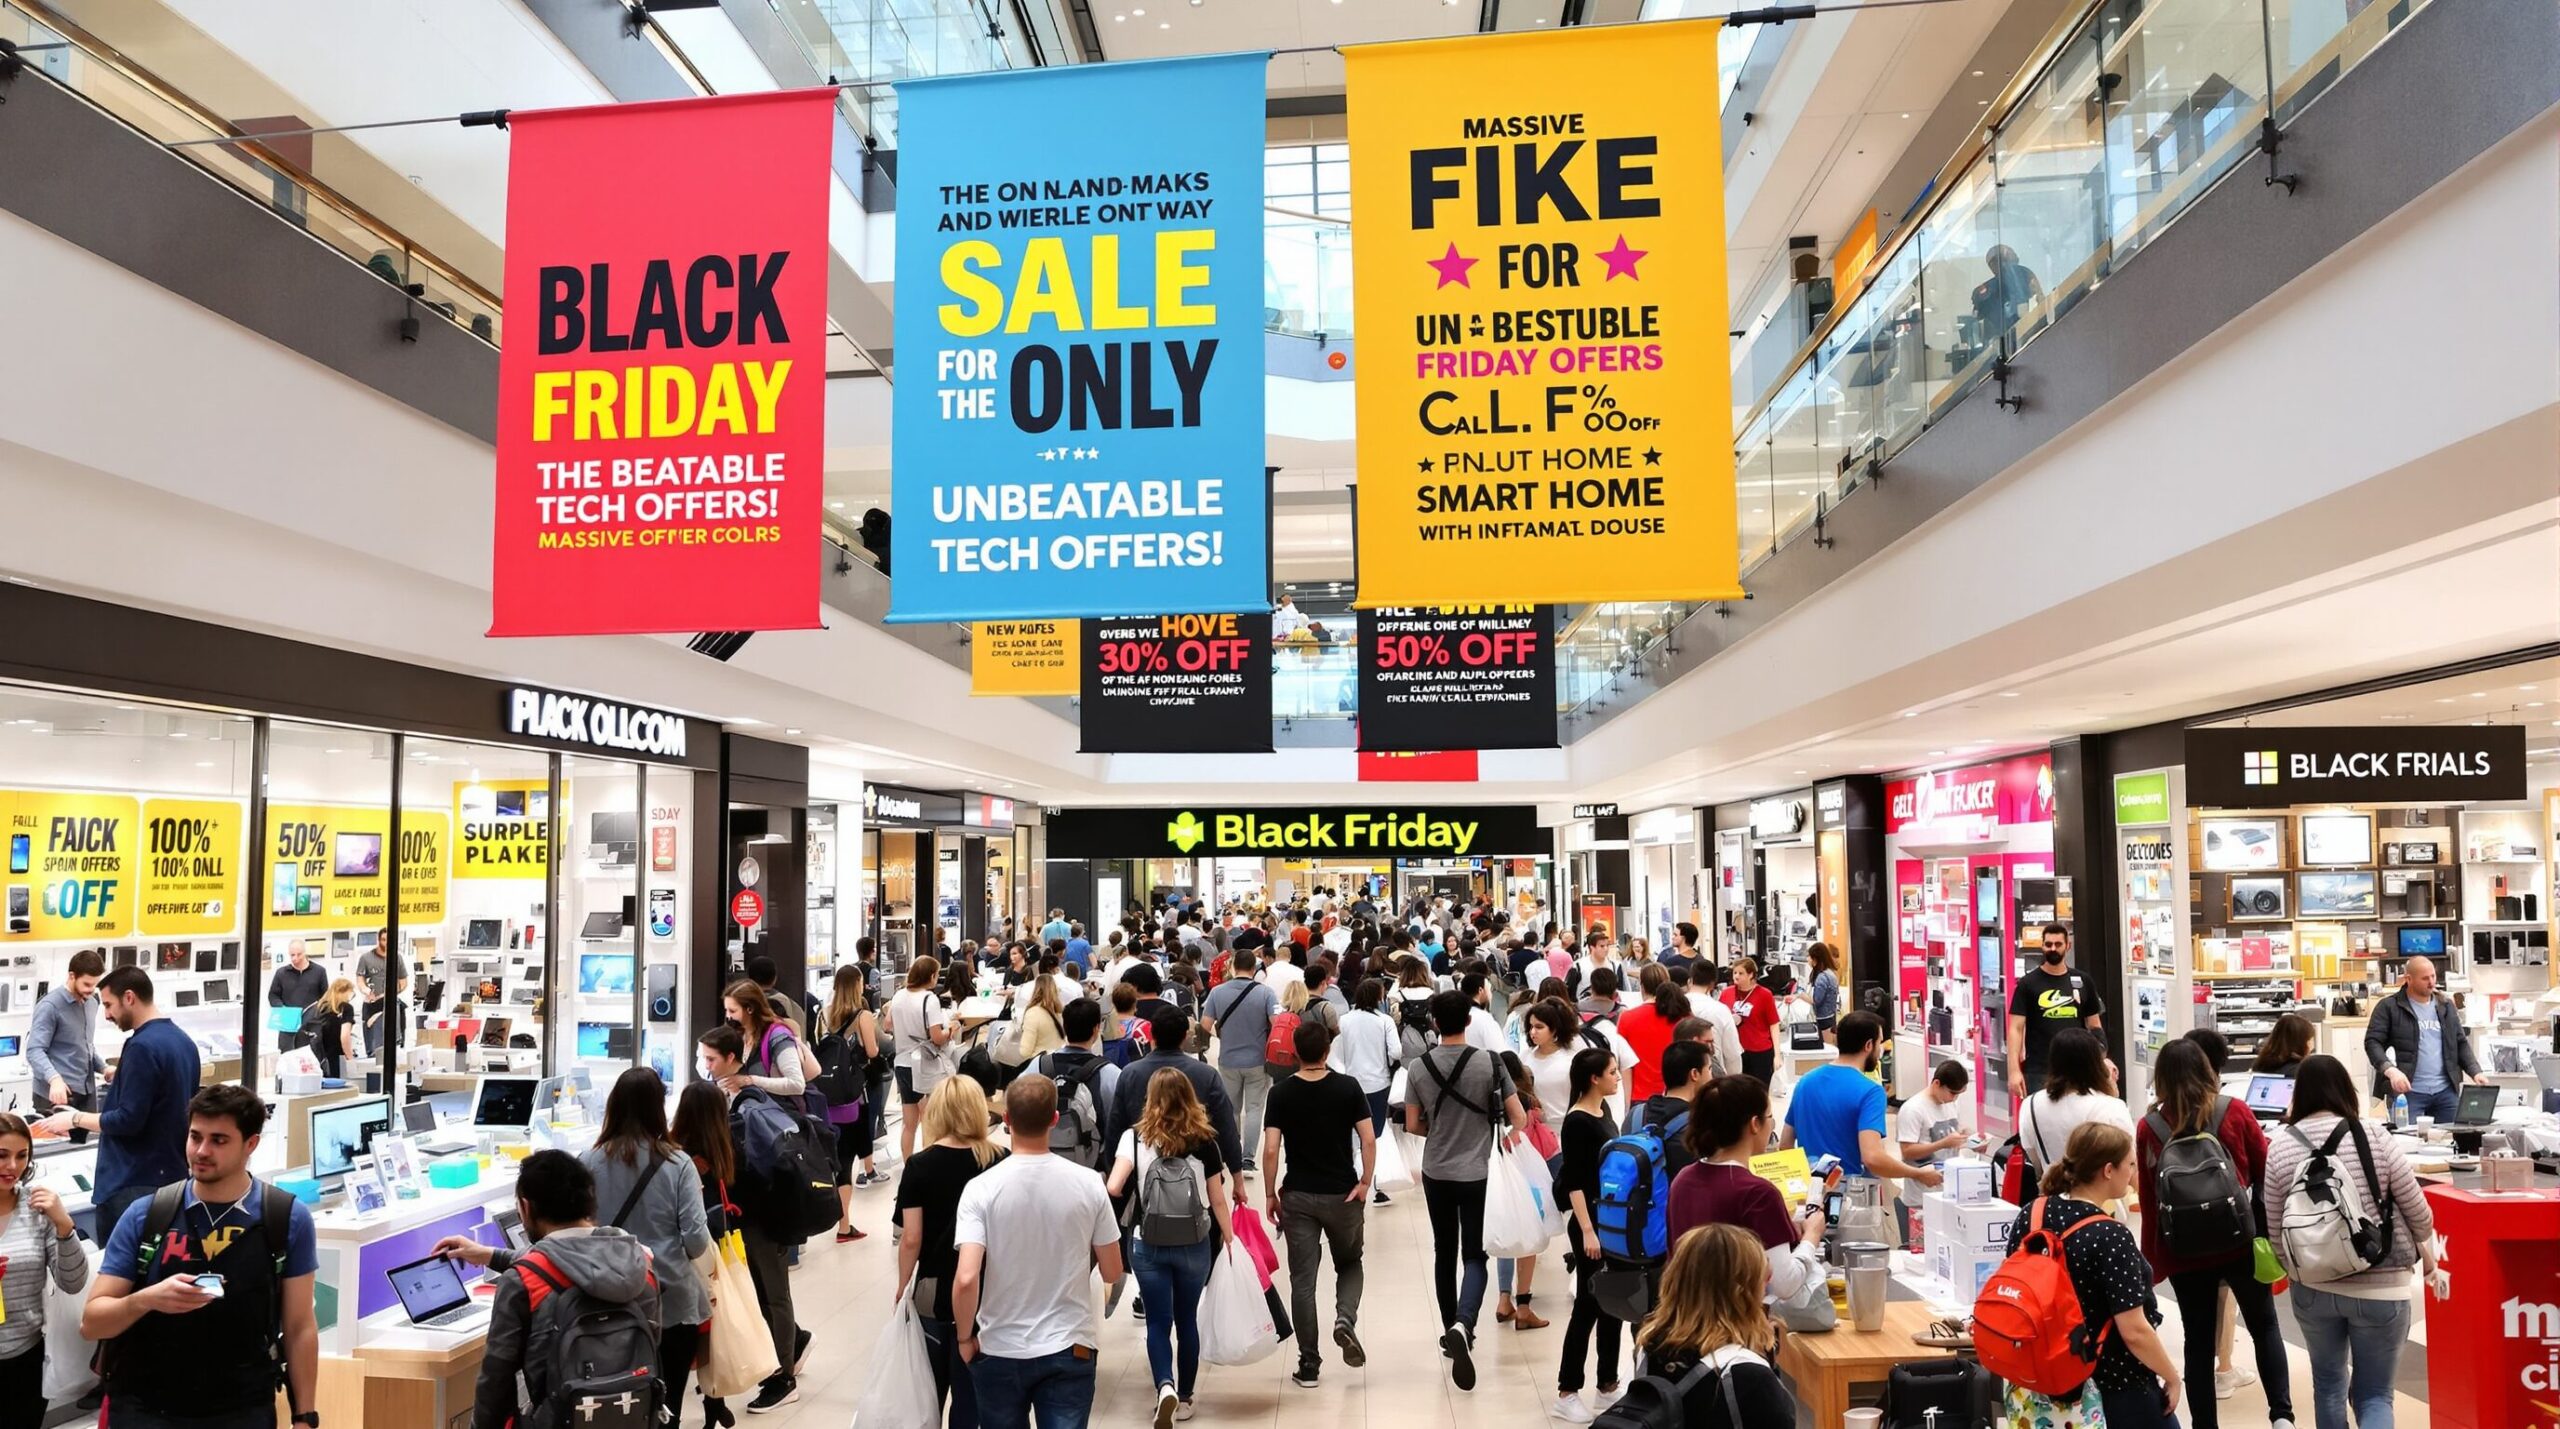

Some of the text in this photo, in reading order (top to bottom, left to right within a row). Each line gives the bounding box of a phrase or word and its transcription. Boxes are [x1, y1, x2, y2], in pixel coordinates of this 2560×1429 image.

[1463, 113, 1585, 139] MASSIVE
[940, 183, 989, 205] THE
[997, 181, 1037, 202] ON
[1409, 135, 1661, 231] FIKE
[937, 199, 1214, 232] AND WIERLE ONT WAY
[1499, 242, 1580, 290] FOR
[938, 229, 1217, 337] SALE
[538, 250, 790, 355] BLACK
[1416, 305, 1660, 347] UN BESTUBLE
[938, 348, 997, 381] FOR
[1416, 344, 1664, 379] FRIDAY OFERS
[532, 360, 793, 442] FRIDAY
[1009, 338, 1219, 434] ONLY
[938, 387, 996, 420] THE
[537, 453, 785, 490] THE BEATABLE
[1543, 446, 1633, 471] HOME
[535, 488, 779, 524] TECH OFFERS!
[932, 479, 1224, 523] UNBEATABLE
[1417, 476, 1665, 513] SMART HOME
[538, 530, 634, 549] MASSIVE
[712, 526, 781, 545] COLRS
[1419, 524, 1472, 541] WITH
[1590, 518, 1665, 536] DOUSE
[930, 531, 1223, 573] TECH OFFERS!
[986, 624, 1015, 636] NEW
[1137, 627, 1160, 639] WE
[1161, 613, 1239, 639] HOVE
[1459, 620, 1476, 631] OF
[1098, 639, 1251, 673] 30% OFF
[1376, 632, 1537, 668] 50% OFF
[1101, 675, 1117, 685] OF
[1434, 670, 1458, 680] AND
[2290, 751, 2491, 779] BLACK FRIALS
[278, 822, 327, 857] 50%
[464, 822, 547, 841] SURPLE
[1216, 812, 1479, 855] Black Friday
[81, 857, 121, 872] OFFERS
[152, 857, 189, 877] 100%
[304, 859, 327, 878] OFF
[466, 845, 547, 864] PLAKE
